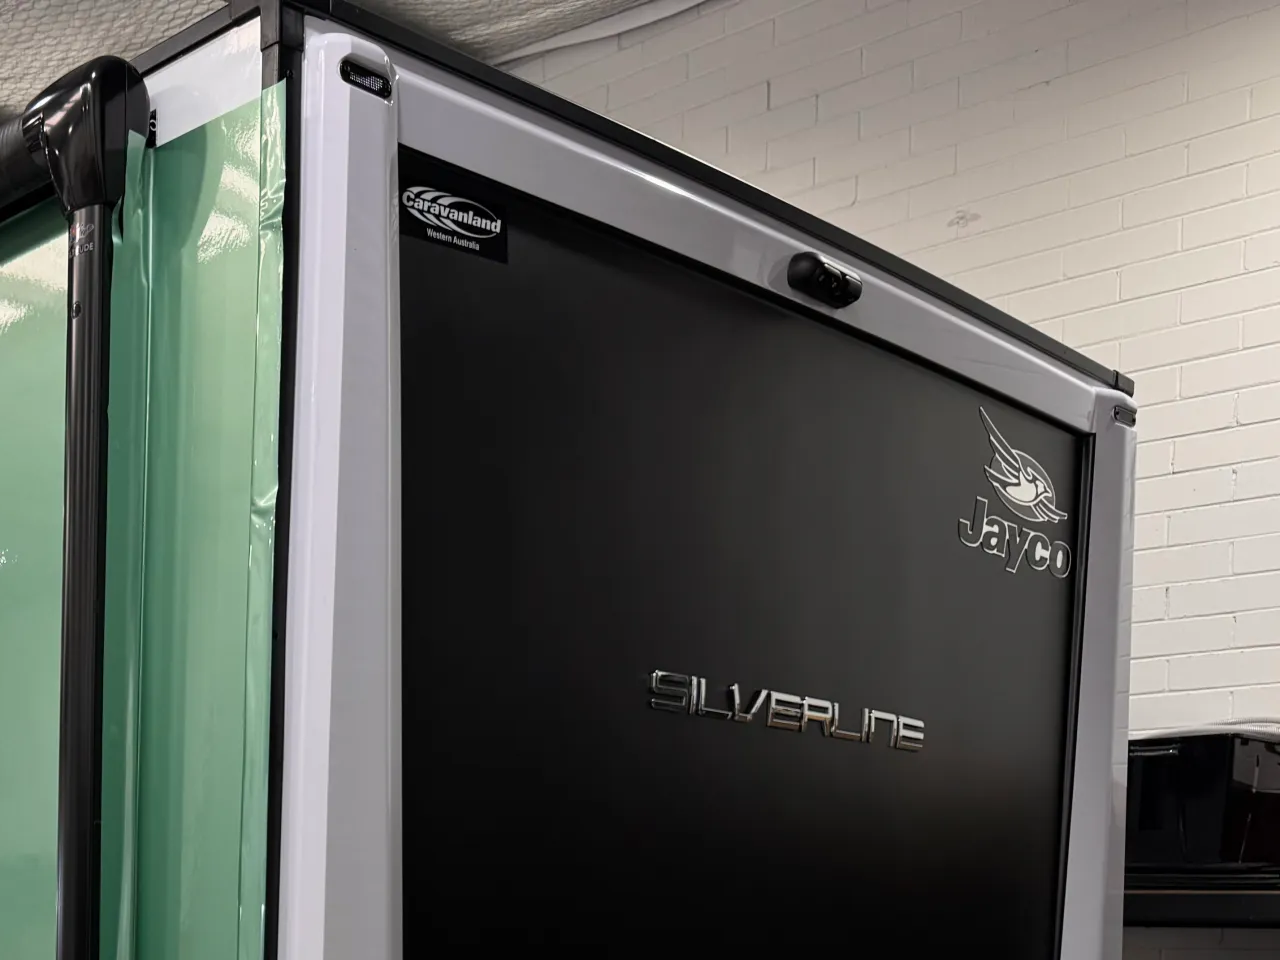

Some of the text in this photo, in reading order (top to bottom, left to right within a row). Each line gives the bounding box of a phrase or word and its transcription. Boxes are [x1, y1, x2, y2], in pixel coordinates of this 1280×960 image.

[402, 191, 501, 233] Caravanland
[427, 228, 480, 250] Western Australia
[958, 496, 1072, 578] Jayco
[649, 669, 925, 751] SILVERLINE
